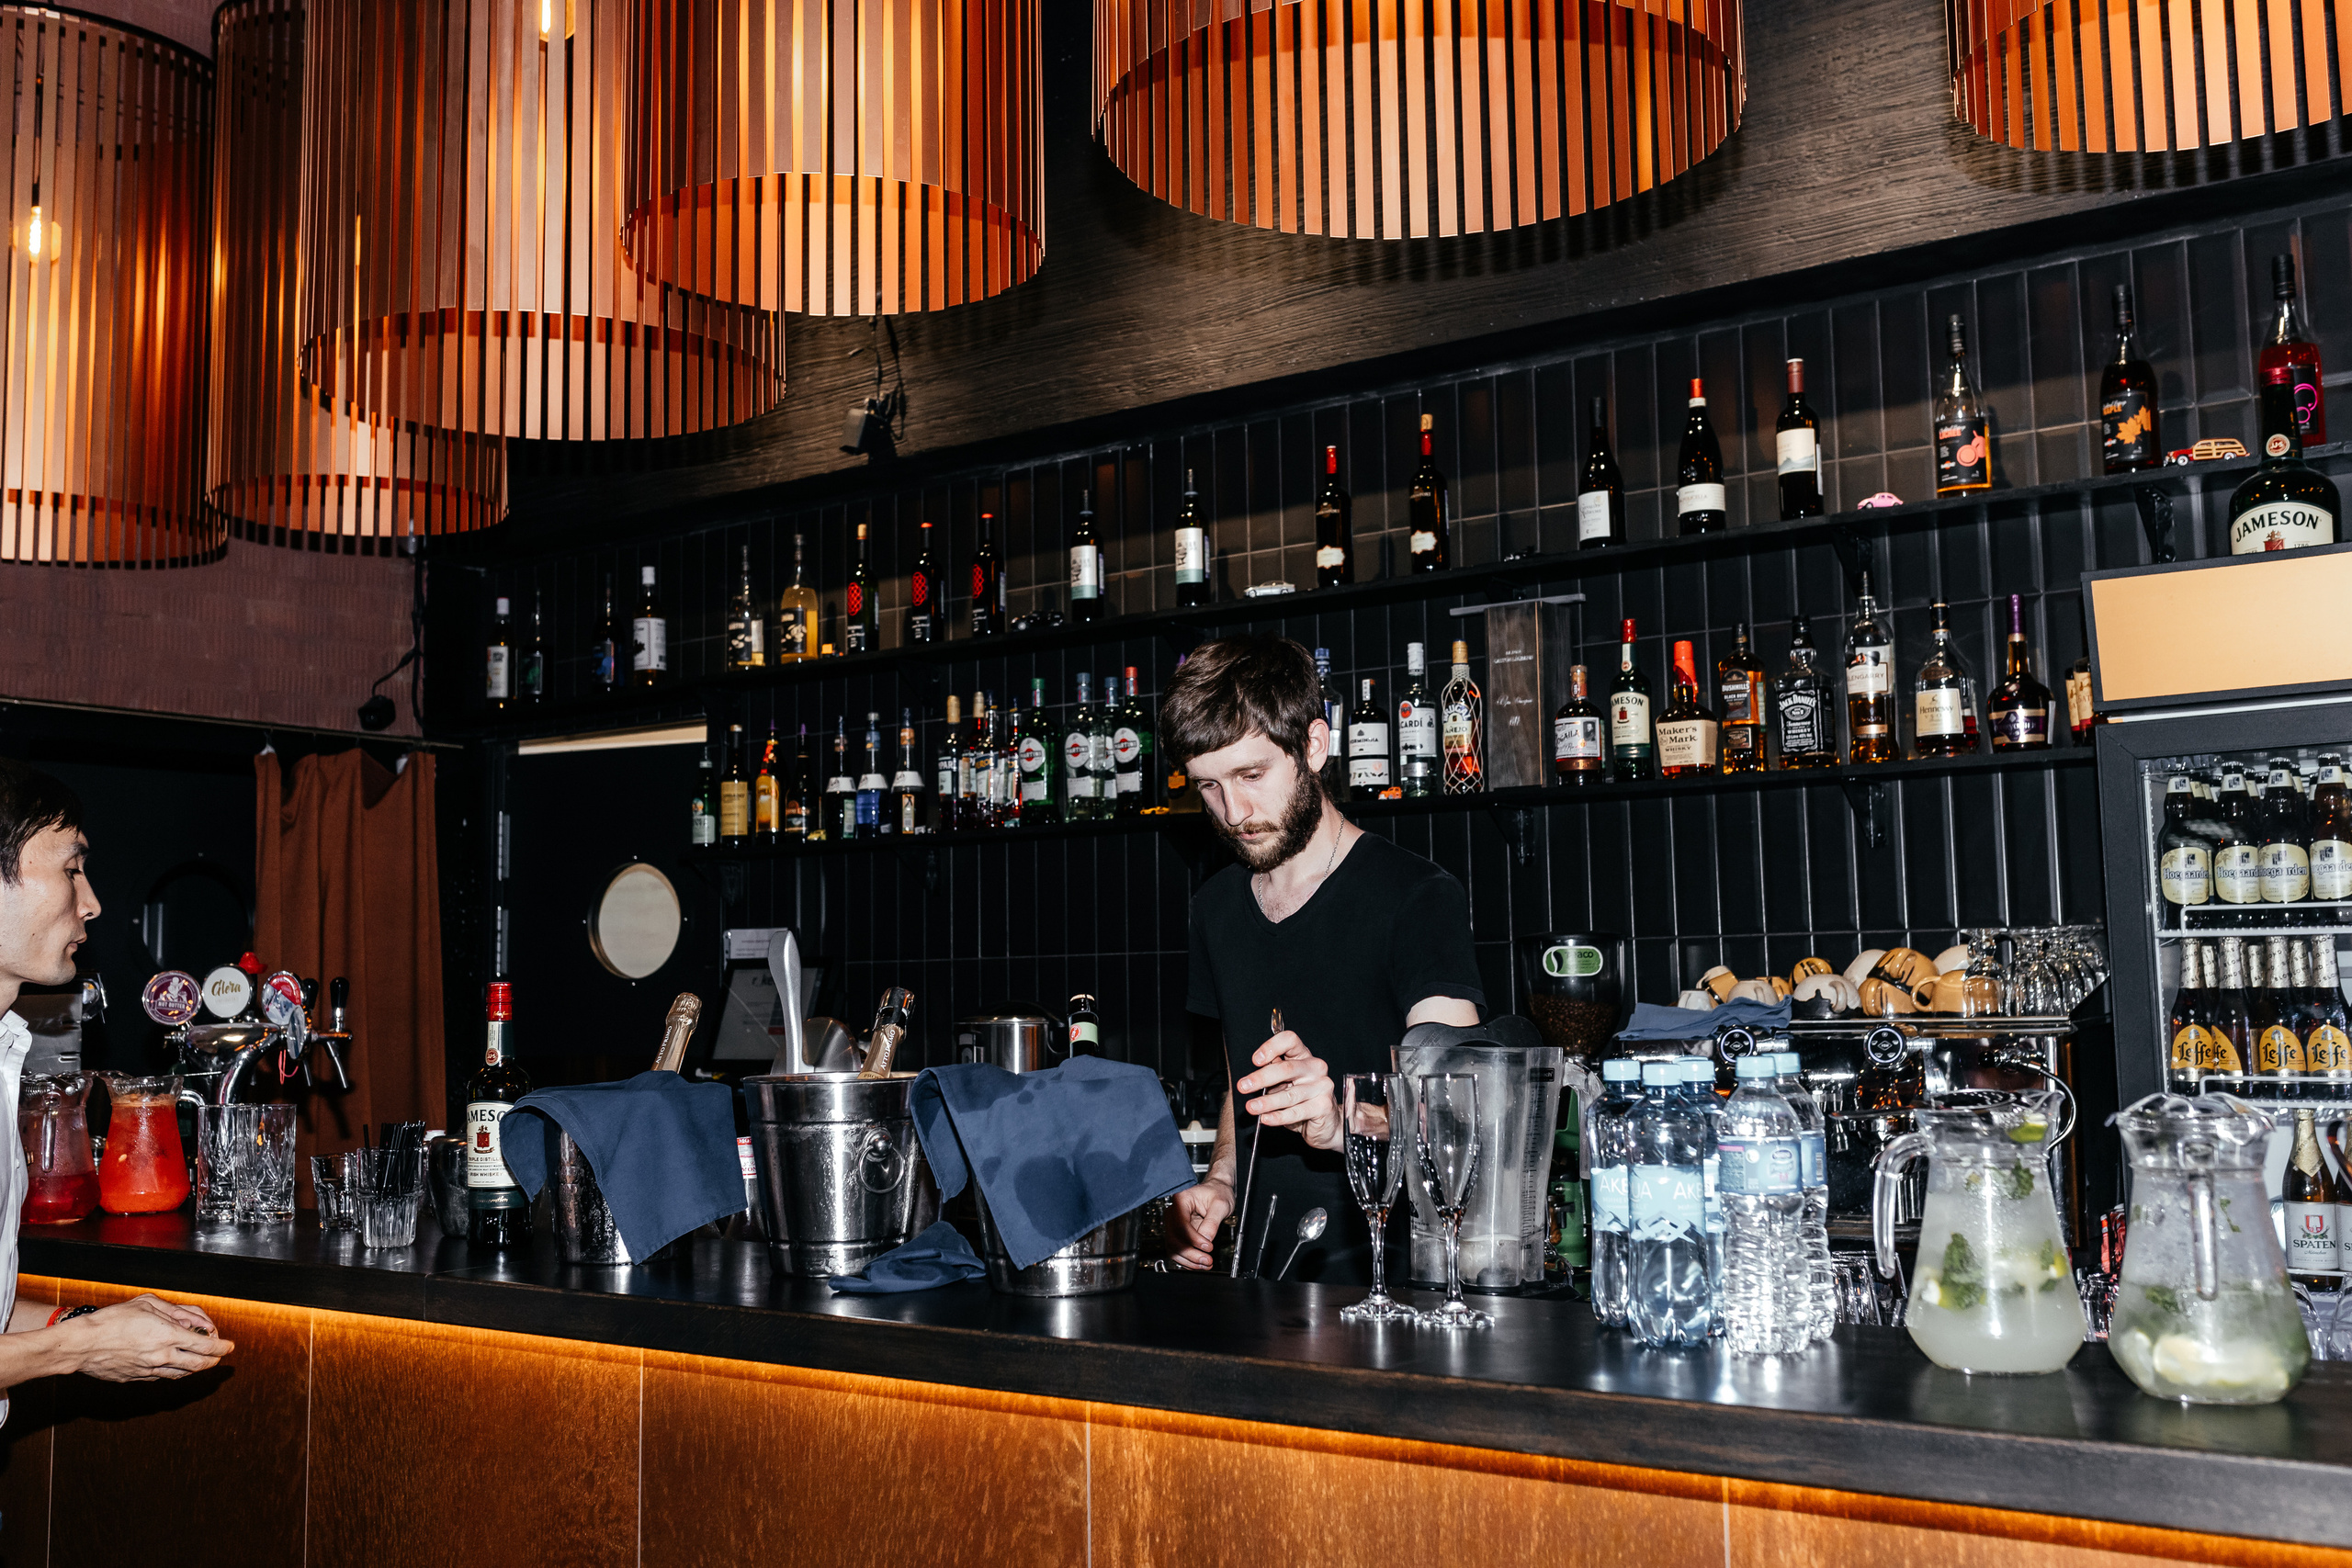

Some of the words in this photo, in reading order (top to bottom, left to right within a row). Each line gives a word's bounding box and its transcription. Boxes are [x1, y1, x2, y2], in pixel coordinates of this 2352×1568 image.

[2235, 511, 2319, 543] JAMESON
[1722, 682, 1750, 693] BUSHMILLS
[1611, 695, 1644, 706] AMESON
[1779, 697, 1793, 711] JACK
[1919, 705, 1953, 715] Hennessy
[1400, 716, 1423, 728] CARDÍ
[1445, 726, 1467, 734] AÑEJO
[1658, 727, 1697, 736] Maker's
[1669, 735, 1697, 744] Mark
[2164, 867, 2209, 881] Hoegaarde
[2217, 865, 2259, 881] Hoegaard
[211, 979, 241, 997] Glera
[2177, 1041, 2211, 1066] Leffe
[2213, 1041, 2227, 1066] ffe
[2262, 1042, 2296, 1067] Leffe
[2311, 1042, 2346, 1068] Leffe
[880, 1051, 890, 1071] ATTO
[467, 1109, 506, 1123] AMESO
[1631, 1182, 1653, 1201] UA
[2292, 1239, 2336, 1249] SPATEN
